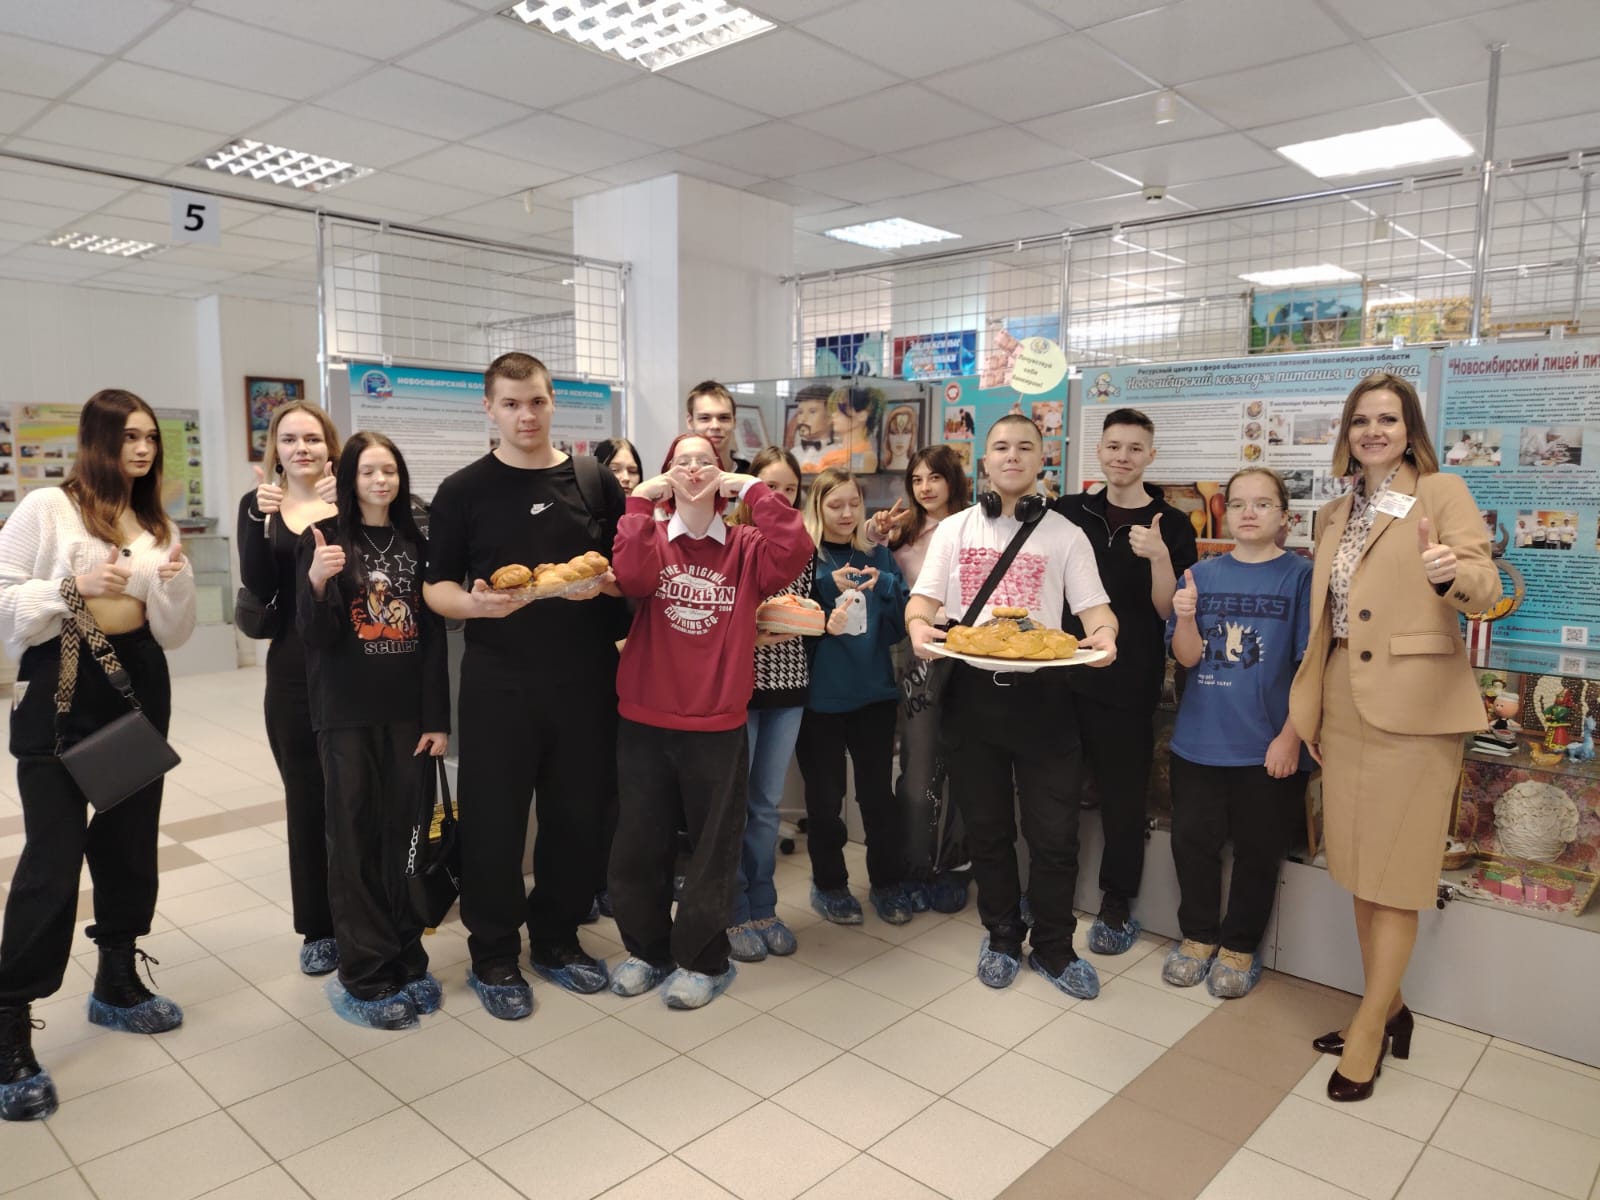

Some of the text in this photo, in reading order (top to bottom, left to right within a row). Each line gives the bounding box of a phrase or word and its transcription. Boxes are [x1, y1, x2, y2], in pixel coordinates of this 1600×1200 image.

[184, 203, 206, 231] 5
[1173, 366, 1193, 374] центр
[1200, 363, 1220, 372] сфере
[1312, 354, 1375, 364] Новосибирской
[1376, 353, 1411, 361] области
[1542, 351, 1579, 373] лицей
[397, 377, 466, 389] НОВОСИБИРСКИЙ
[1126, 372, 1213, 393] Новосибирский
[1215, 372, 1275, 390] колледж
[1276, 368, 1341, 383] питания
[1344, 368, 1355, 380] и
[660, 564, 681, 578] THE
[683, 563, 727, 585] RIGINAL
[663, 606, 702, 630] CLOTHING
